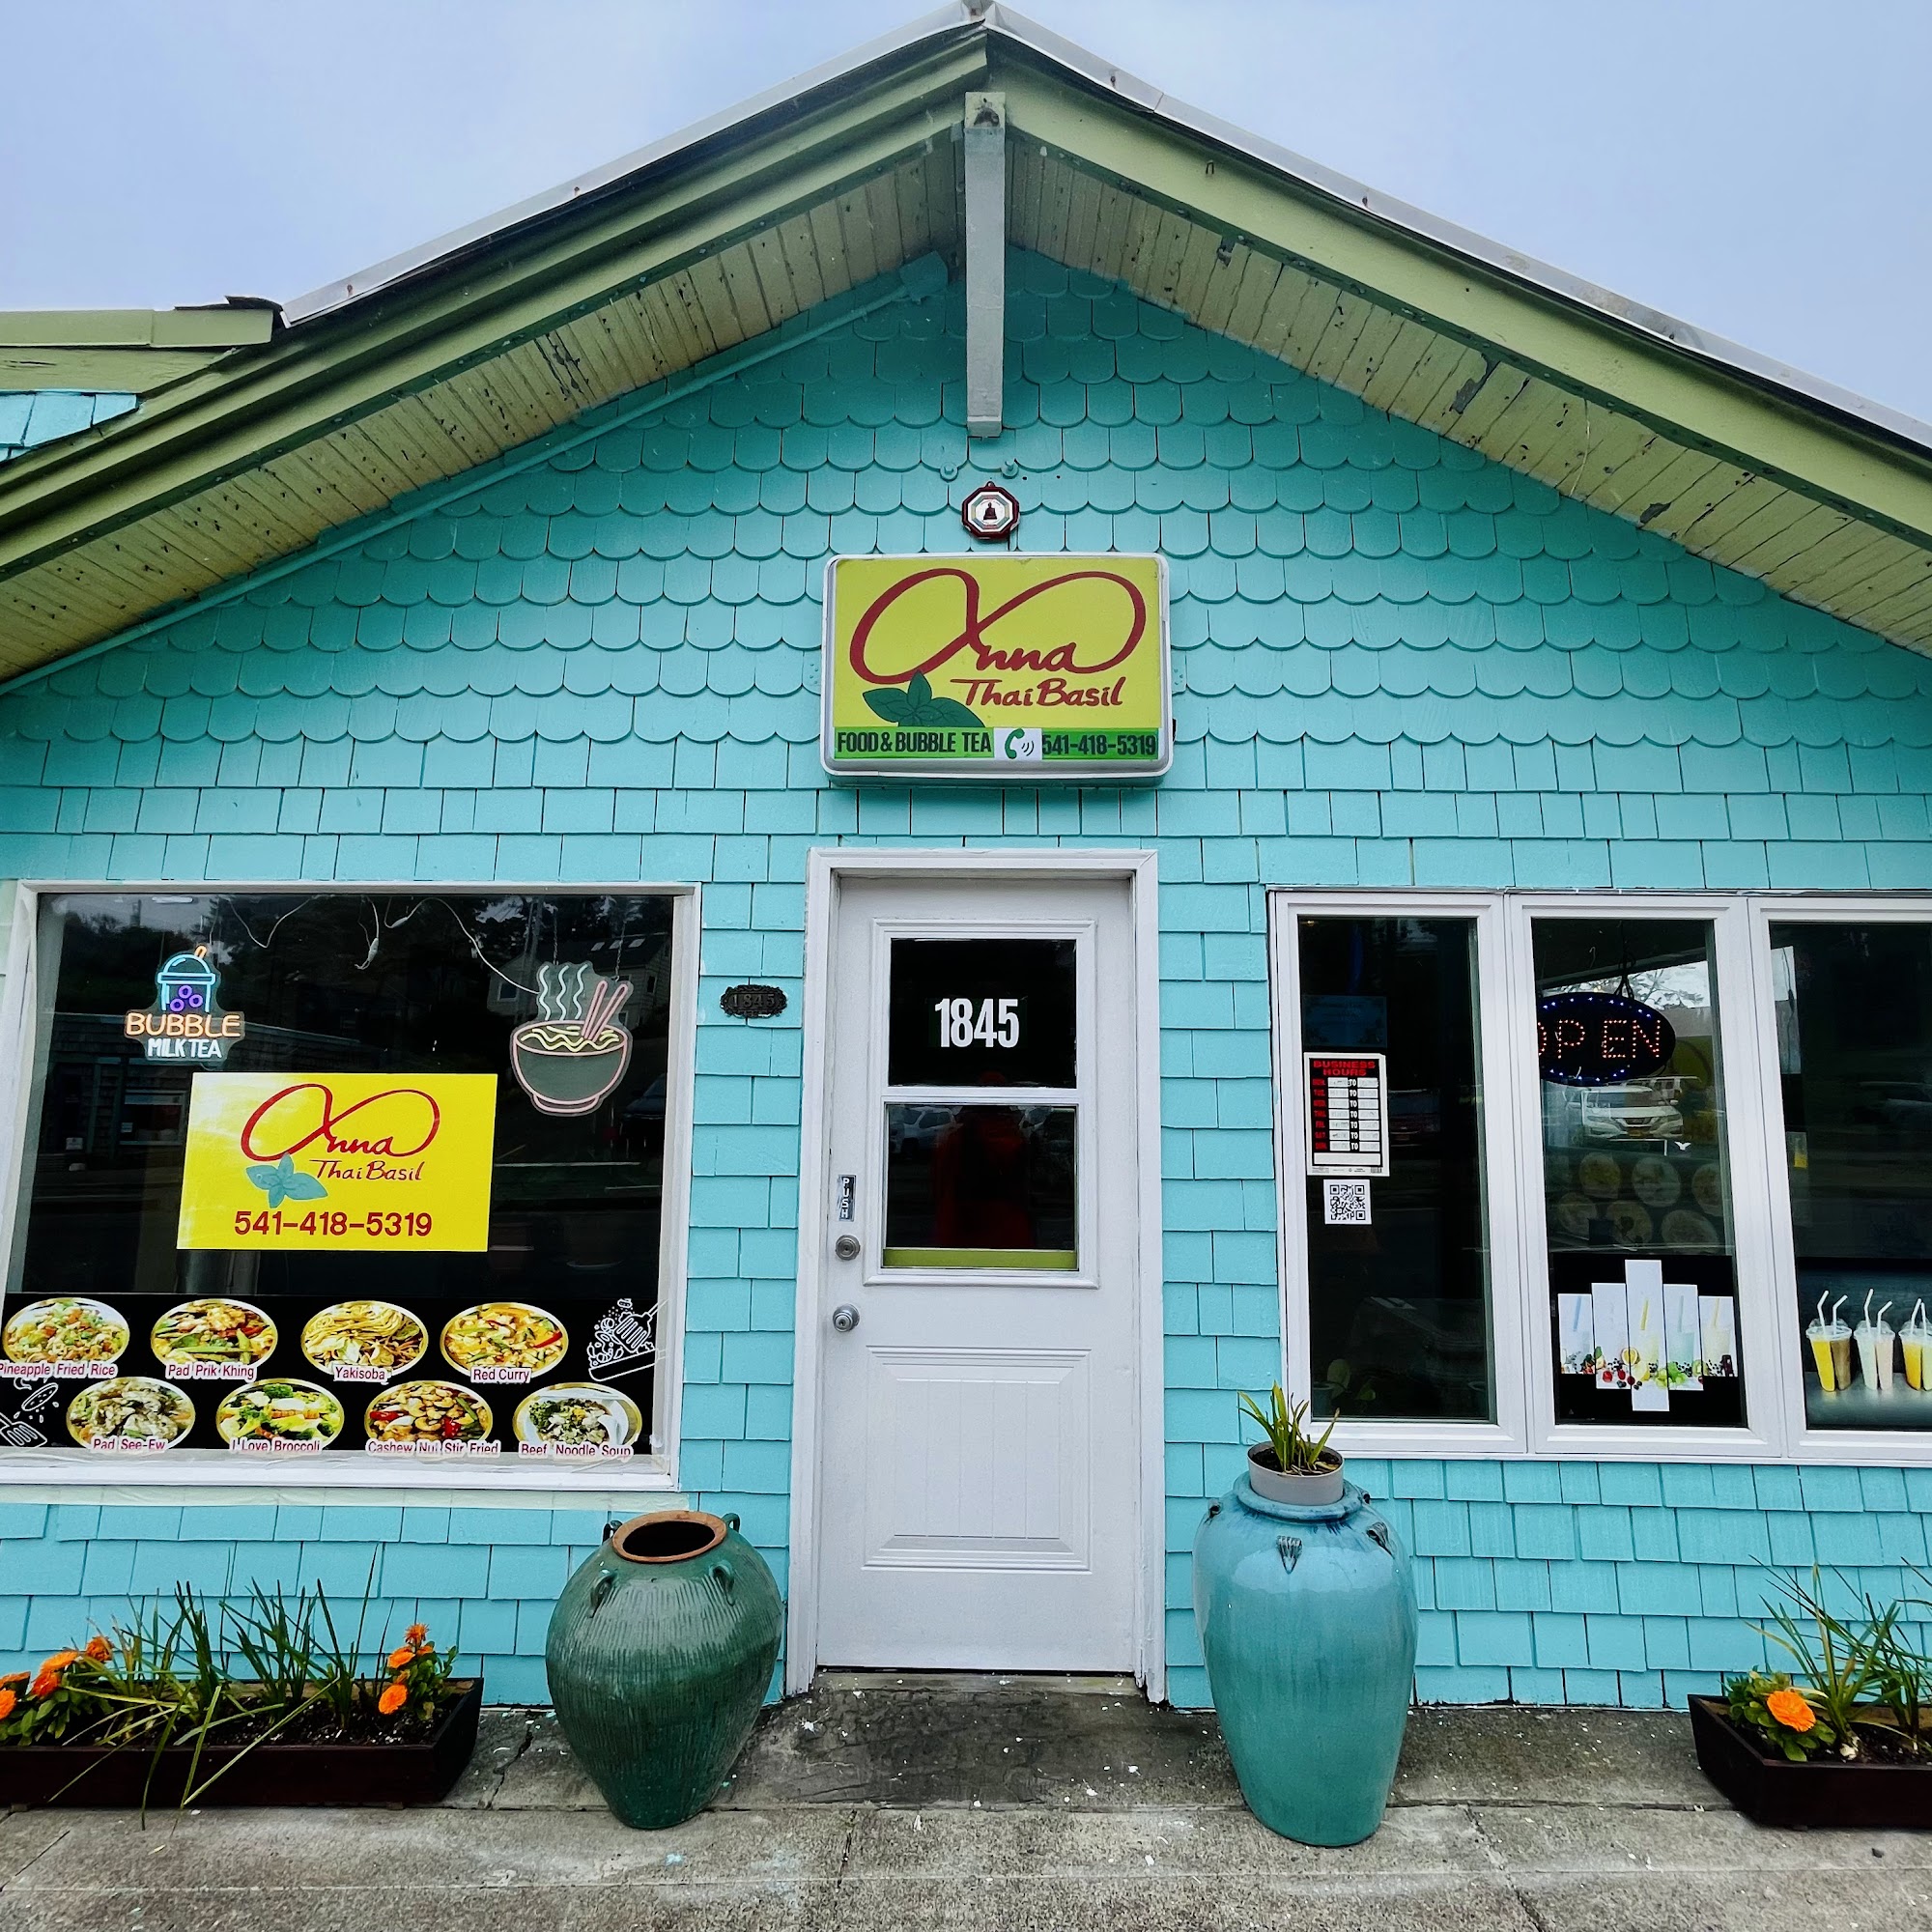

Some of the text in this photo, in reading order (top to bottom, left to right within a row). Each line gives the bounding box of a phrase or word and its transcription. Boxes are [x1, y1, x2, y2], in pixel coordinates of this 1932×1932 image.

[950, 676, 1126, 707] Thai Basil
[837, 732, 991, 753] FOOD & BUBBLE TEA
[1041, 735, 1156, 754] 541-418-5319
[731, 993, 776, 1008] 1845
[126, 1012, 241, 1037] BUBBLE
[934, 998, 1019, 1047] 1845
[147, 1038, 222, 1058] MILK TEA
[308, 1160, 425, 1180] Thai Basil
[840, 1178, 850, 1218] PUSH
[234, 1210, 432, 1236] 541-418-5319
[57, 1364, 85, 1375] Fried
[91, 1364, 116, 1376] Rice
[168, 1365, 254, 1379] Pad Prik Khing
[334, 1367, 385, 1380] Yakisoba
[473, 1368, 530, 1382] Red Curry
[94, 1438, 115, 1449] Pad
[242, 1439, 269, 1451] Love
[274, 1440, 321, 1451] Broccoli
[369, 1440, 413, 1453] Cashew
[444, 1442, 465, 1453] Stir
[469, 1442, 498, 1454] Fried
[522, 1443, 631, 1457] Beef Noodle Soup
